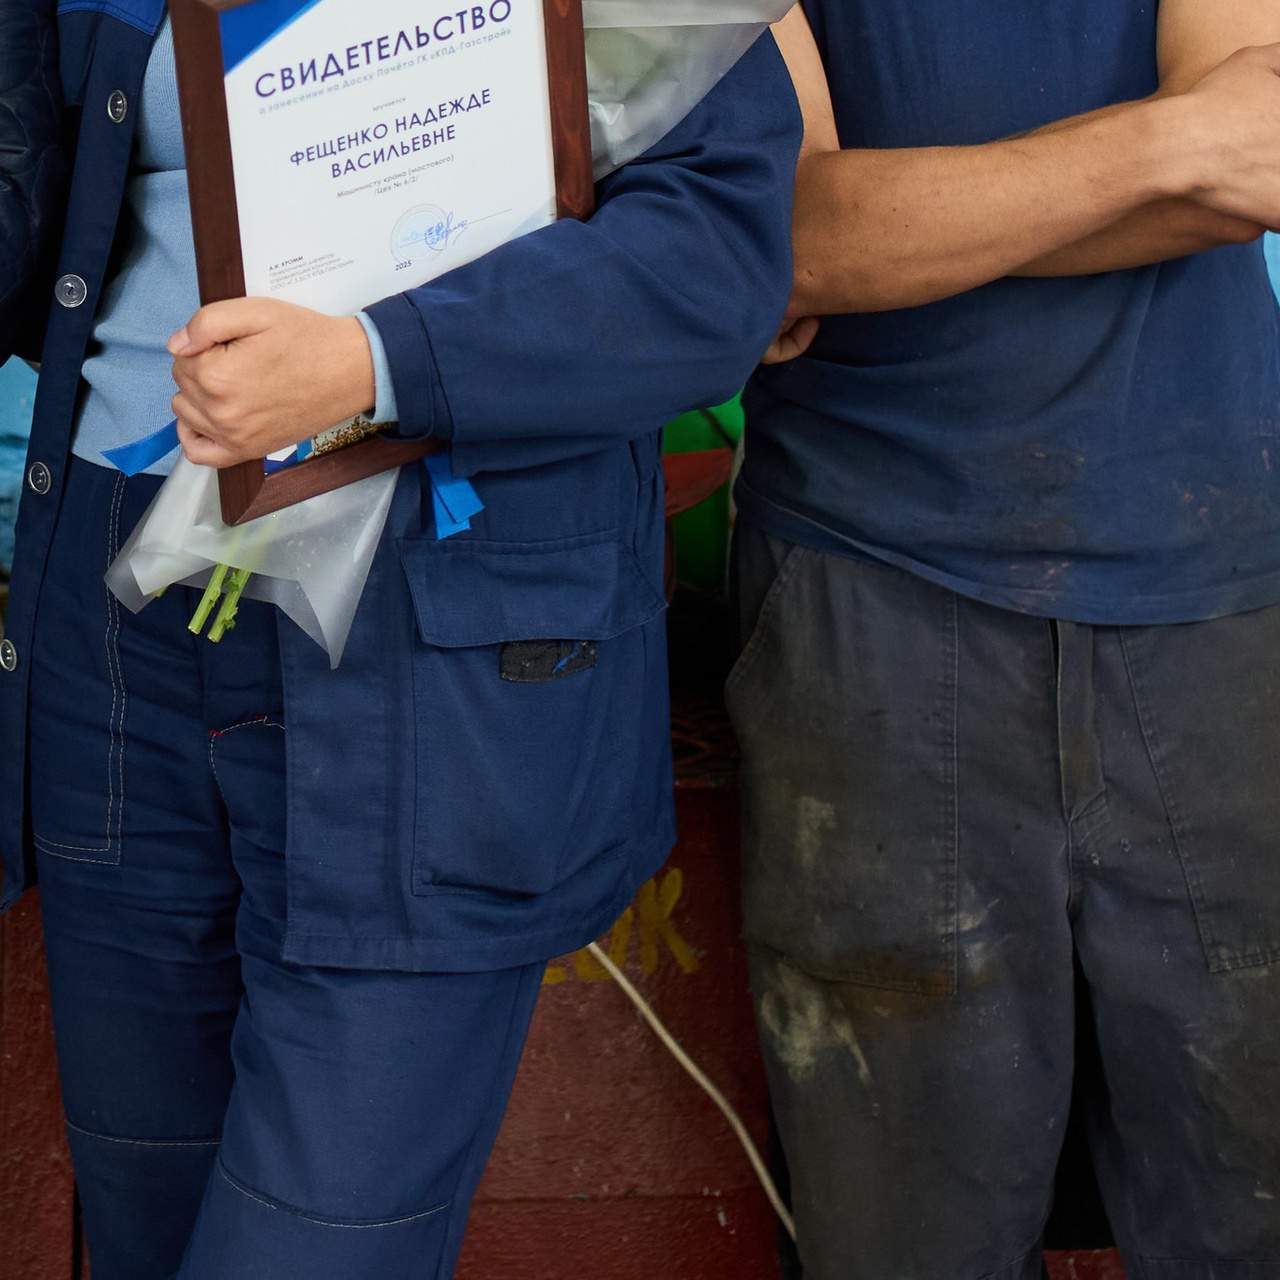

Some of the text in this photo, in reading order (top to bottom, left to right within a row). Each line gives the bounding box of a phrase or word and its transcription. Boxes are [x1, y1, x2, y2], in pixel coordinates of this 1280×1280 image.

[259, 107, 266, 115] о
[268, 89, 324, 112] занесении
[327, 84, 340, 93] на
[342, 72, 374, 89] Доску
[377, 60, 414, 77] Почёта
[416, 53, 428, 65] ГК
[290, 88, 491, 166] ФЕЩЕНКО НАДЕЖДЕ
[331, 124, 456, 178] ВАСИЛЬЕВНЕ
[337, 154, 455, 198] Машинисту крана (мостового)
[395, 260, 412, 271] 2025
